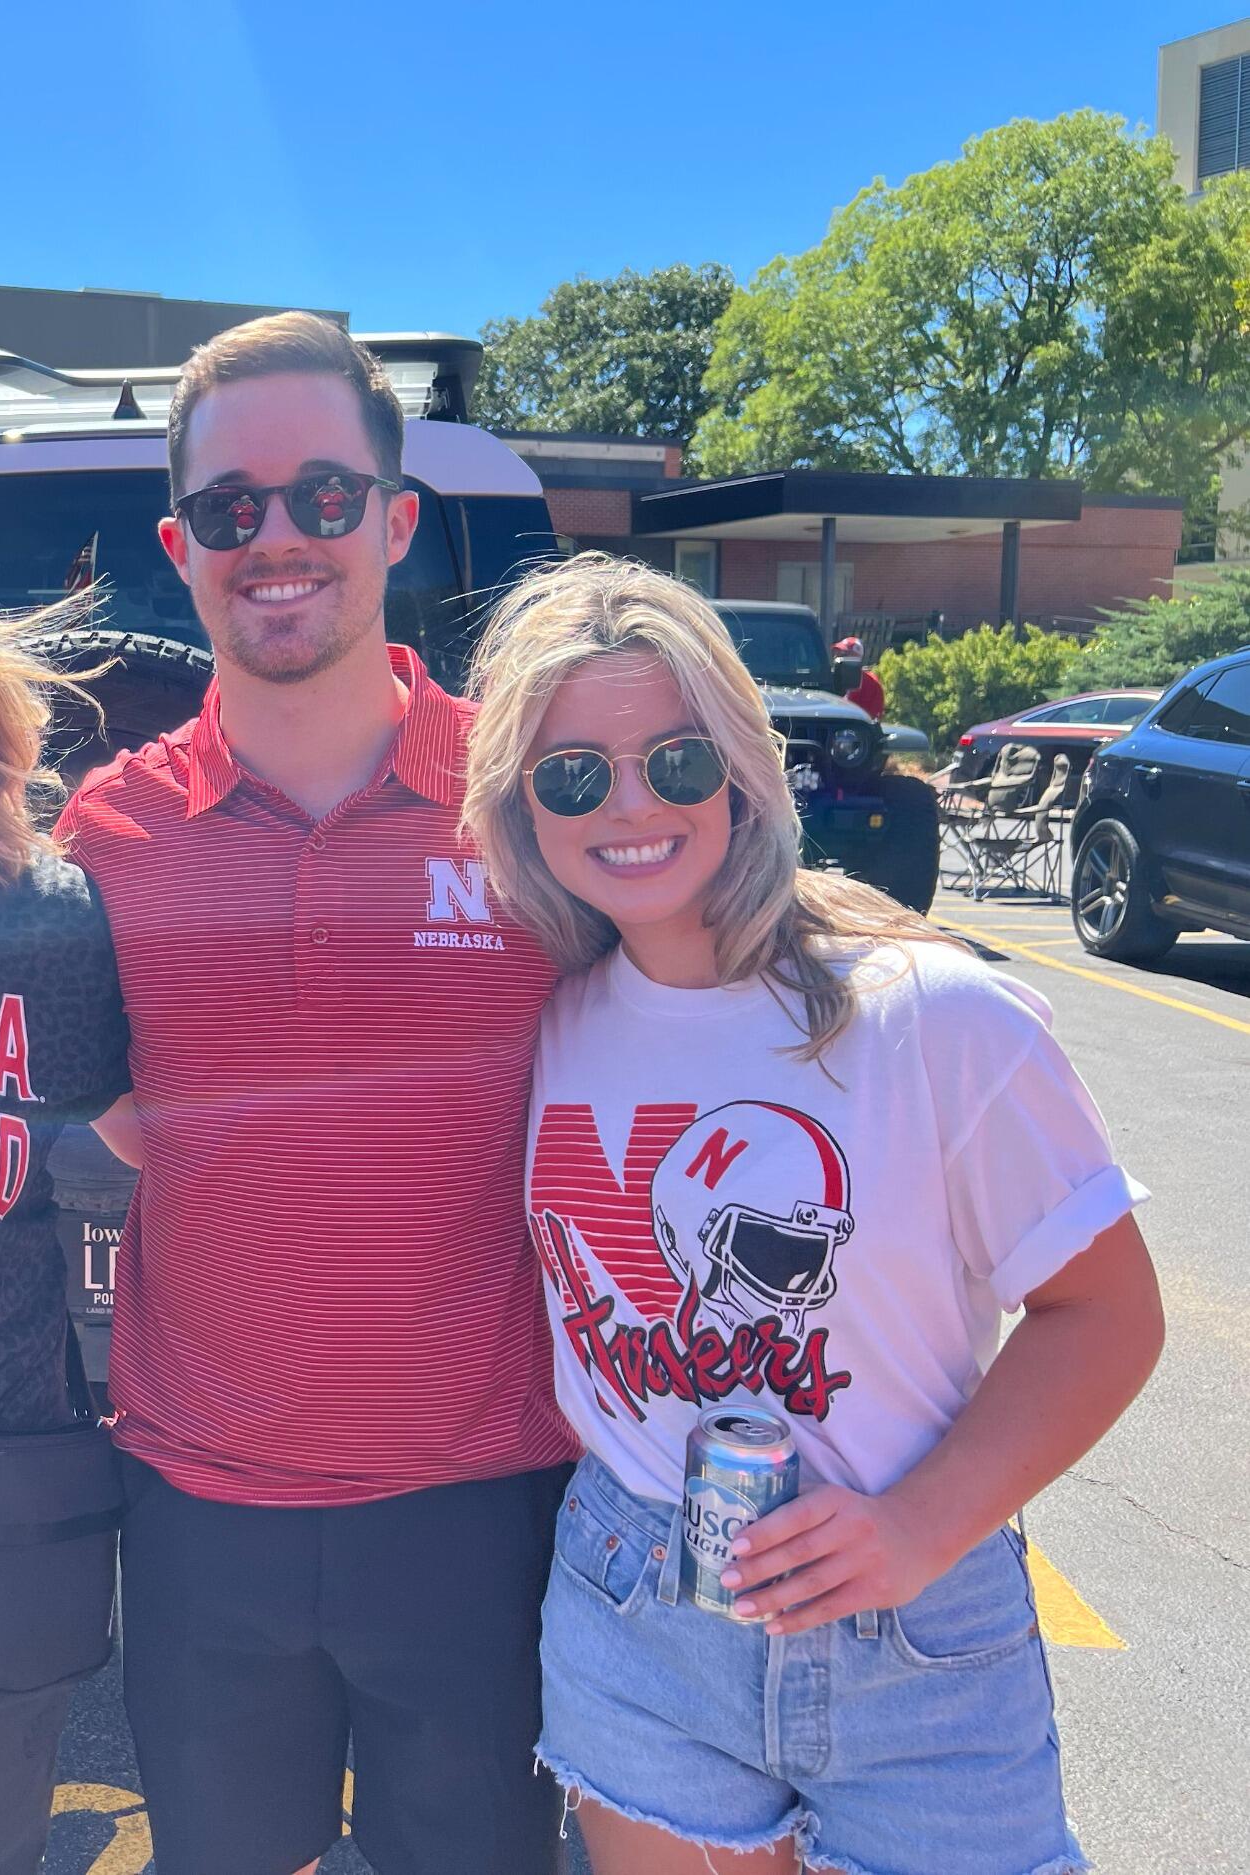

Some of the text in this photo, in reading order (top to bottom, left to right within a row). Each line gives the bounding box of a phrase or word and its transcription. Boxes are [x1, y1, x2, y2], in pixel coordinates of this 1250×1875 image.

[425, 857, 494, 924] N
[413, 931, 506, 951] NEBRASKA
[684, 1127, 749, 1191] N
[83, 1222, 124, 1243] Iow
[529, 1208, 852, 1423] Huskers
[682, 1492, 755, 1542] USC
[686, 1527, 738, 1561] LIGH
